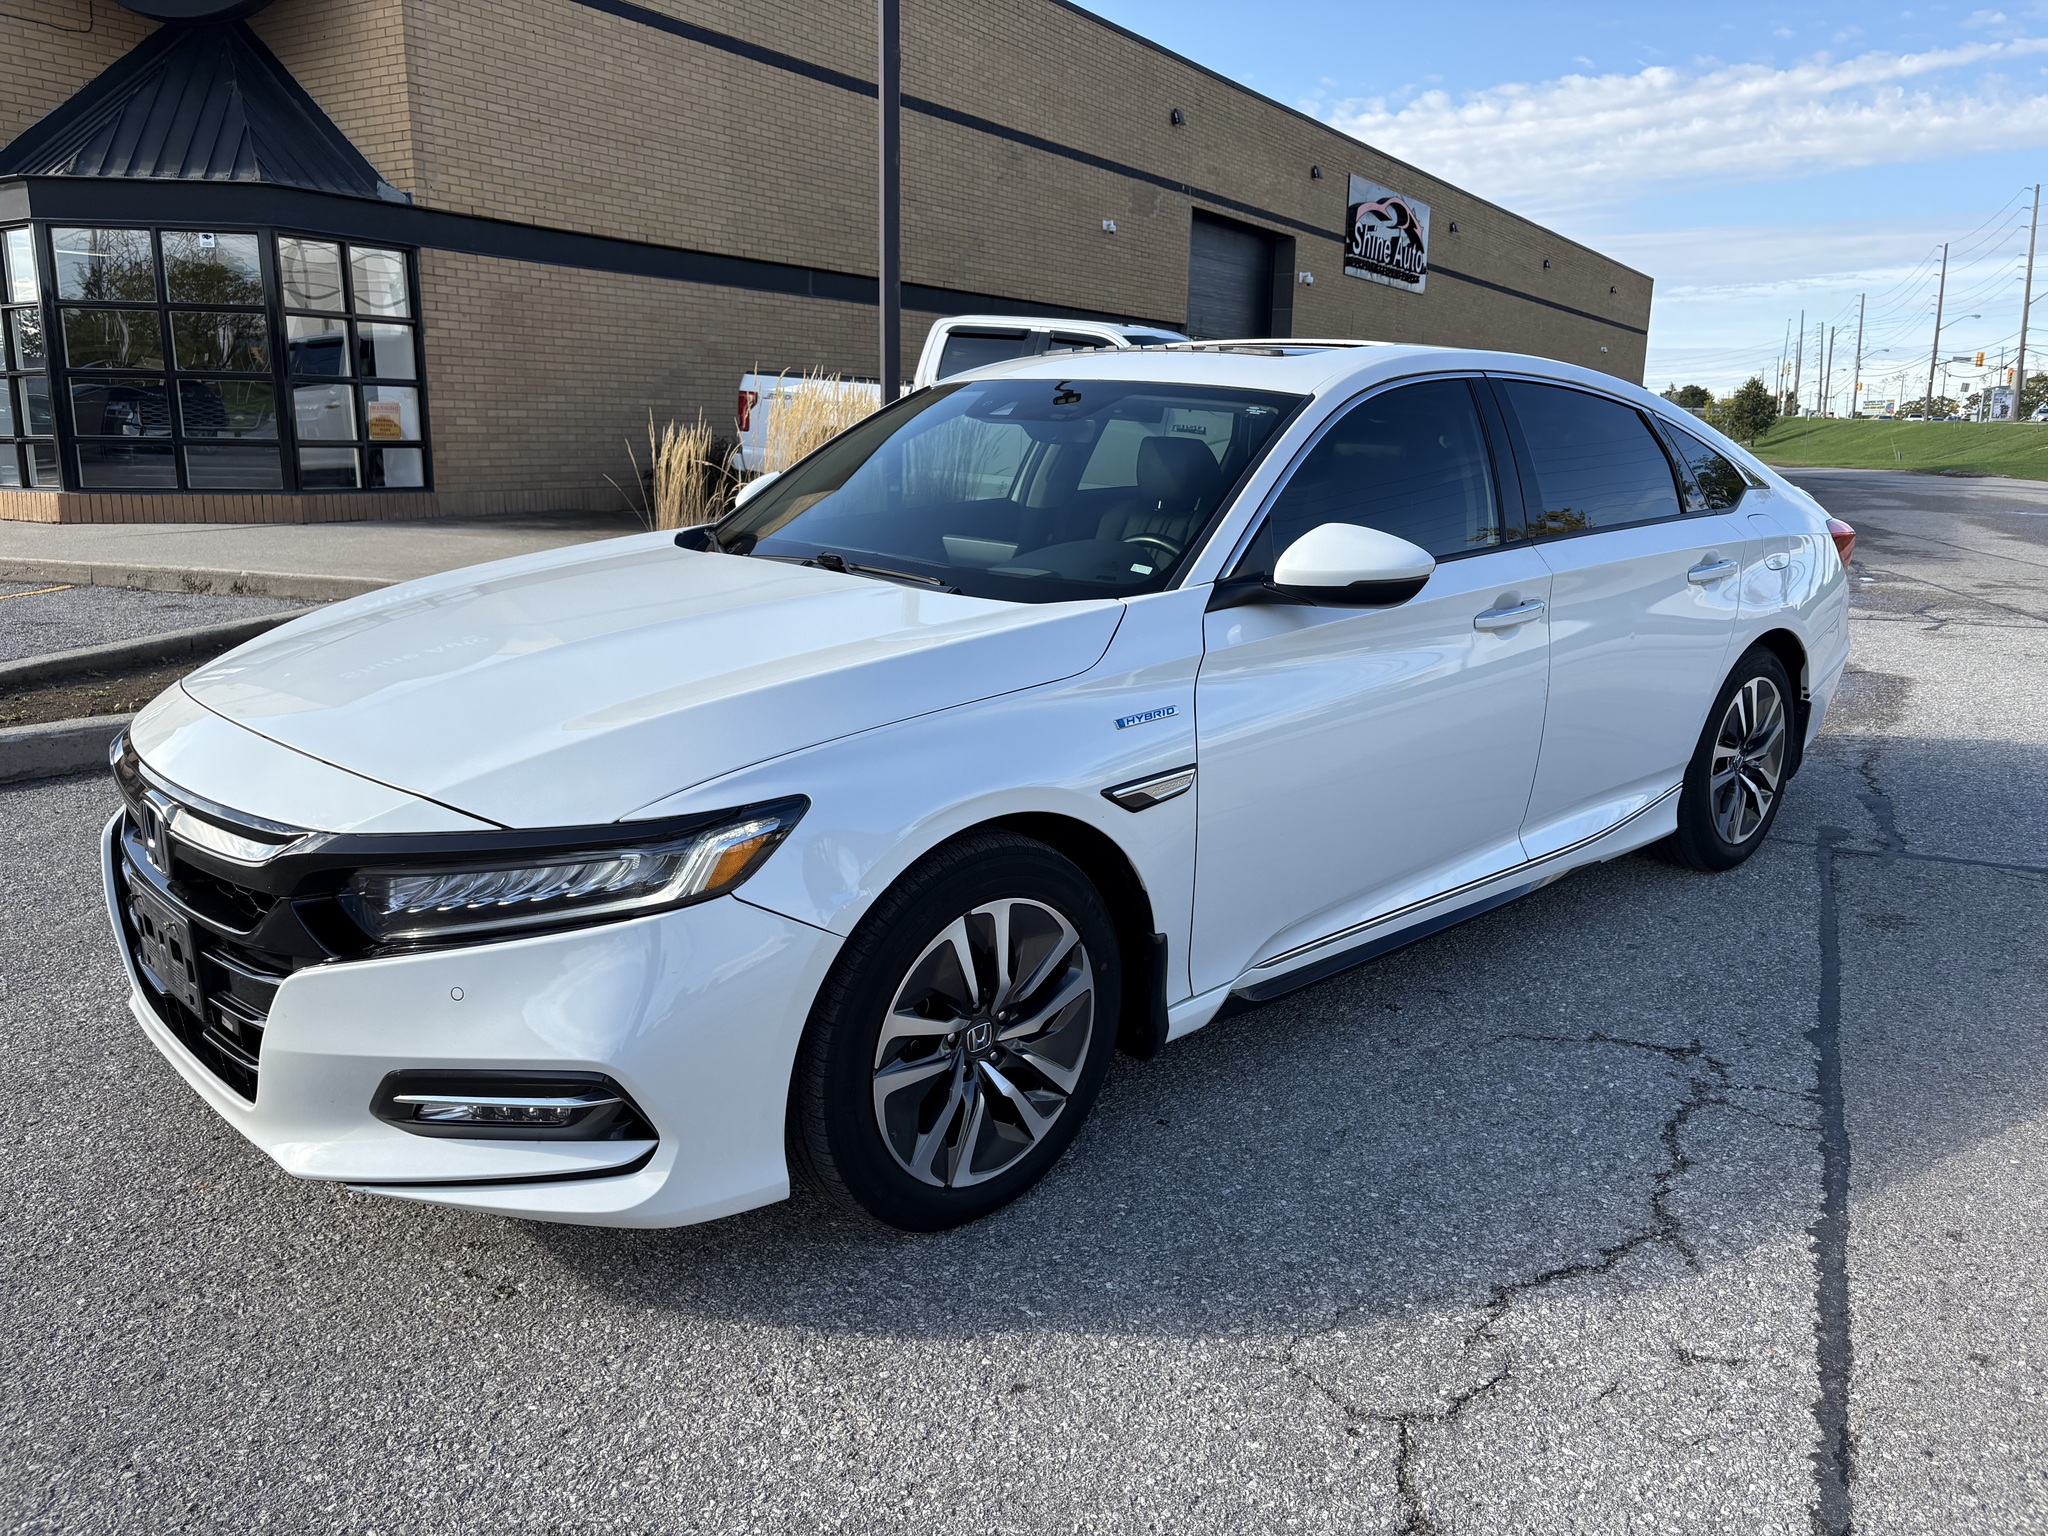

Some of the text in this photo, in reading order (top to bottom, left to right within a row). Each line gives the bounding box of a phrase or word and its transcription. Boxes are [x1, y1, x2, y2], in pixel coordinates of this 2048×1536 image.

[1352, 221, 1392, 264] Shine
[1393, 236, 1424, 273] Auto
[1126, 707, 1175, 726] HYBRID
